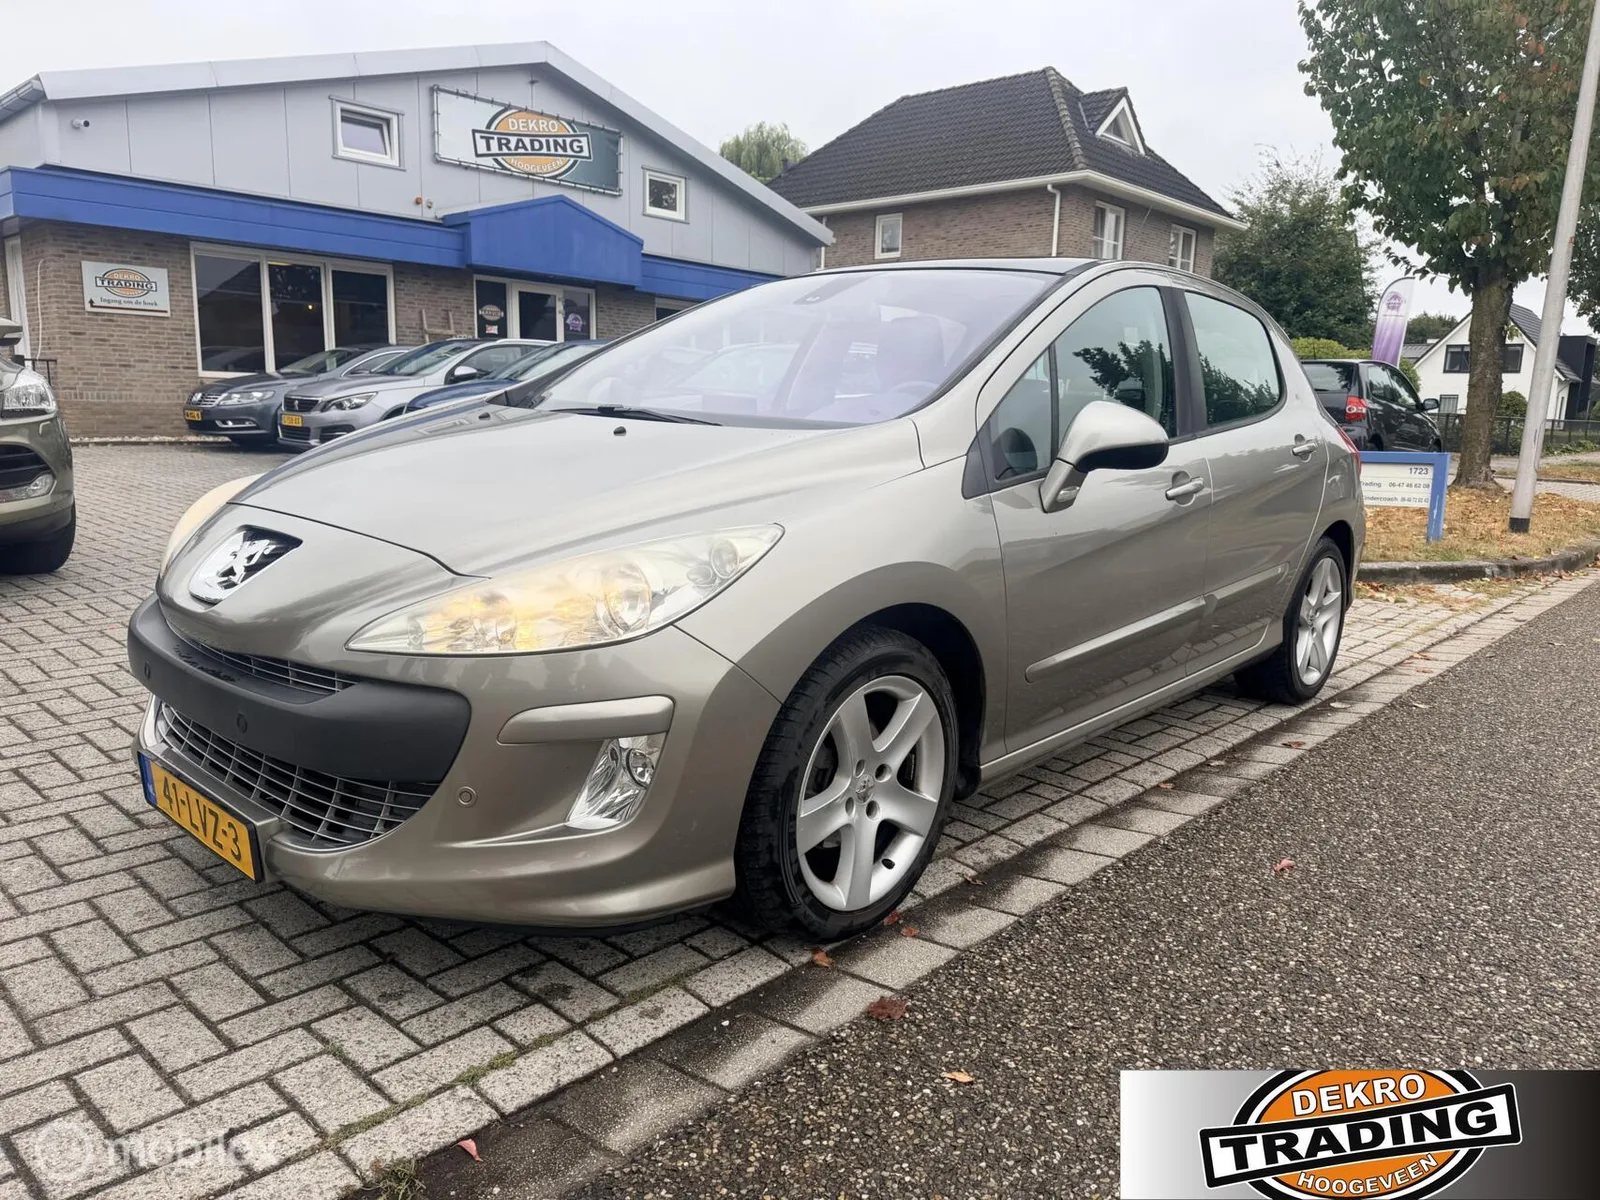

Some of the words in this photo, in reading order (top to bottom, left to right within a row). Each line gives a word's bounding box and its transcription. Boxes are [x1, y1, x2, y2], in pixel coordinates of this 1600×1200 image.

[508, 118, 559, 133] DEKRO
[480, 135, 584, 154] TRADING
[510, 158, 563, 173] HOOGEVEEN
[99, 279, 154, 290] TRADING
[1409, 467, 1429, 475] 1723
[162, 776, 242, 861] 41-LVZ-3
